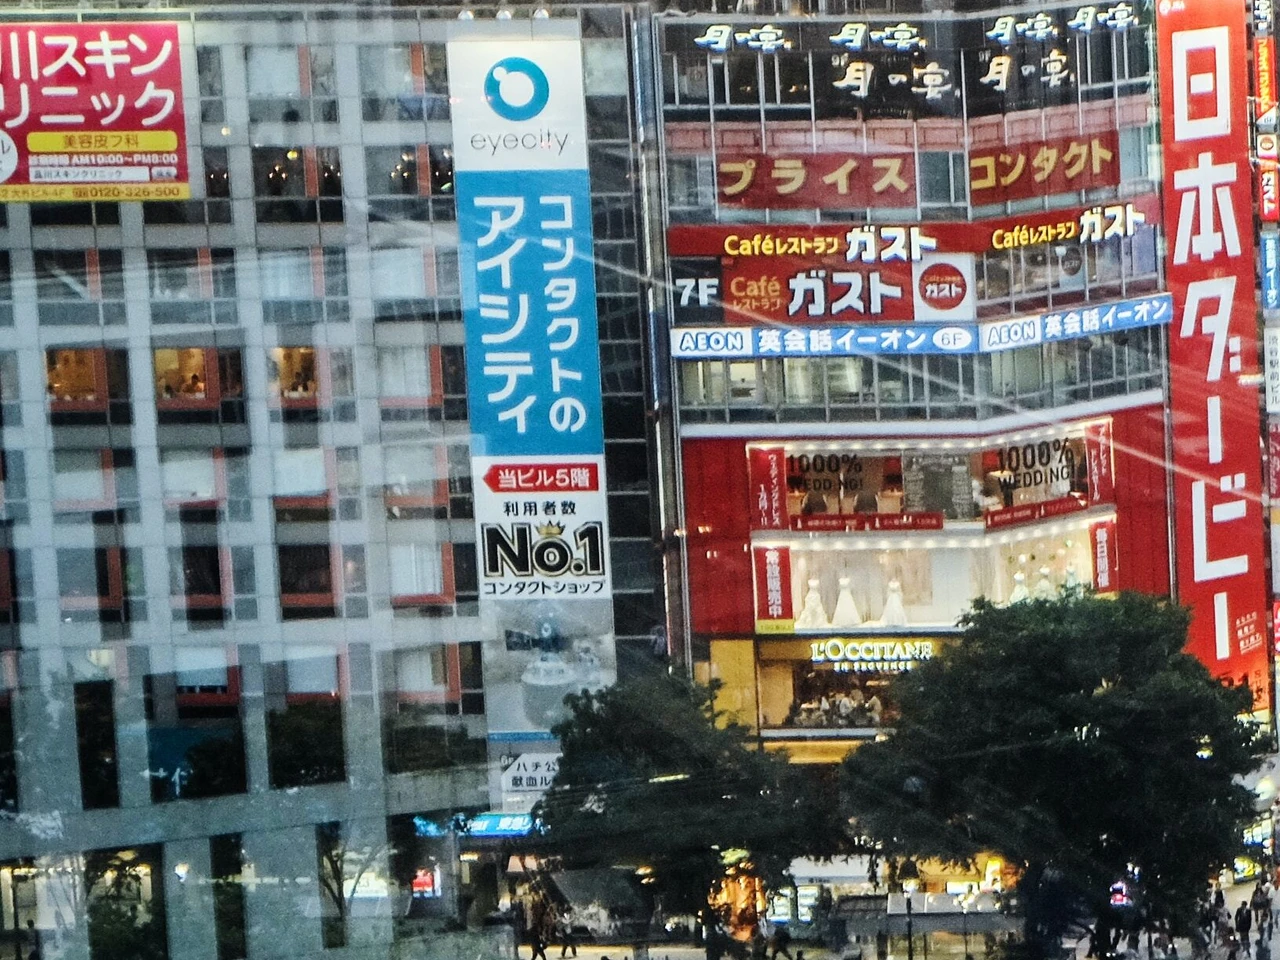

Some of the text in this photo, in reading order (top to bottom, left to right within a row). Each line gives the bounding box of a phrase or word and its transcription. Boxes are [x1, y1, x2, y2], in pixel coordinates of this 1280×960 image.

[62, 134, 139, 149] 美容皮フ科
[470, 128, 569, 156] eyecity
[719, 158, 909, 196] プライス
[970, 138, 1112, 190] コンタクト
[1079, 203, 1145, 244] ガスト
[846, 225, 937, 262] ガスト
[675, 278, 719, 307] 7F
[730, 275, 781, 298] Café
[788, 269, 902, 317] ガスト
[925, 282, 963, 298] ガスト
[472, 196, 537, 434] アイシティ
[539, 195, 588, 434] コンタクトの
[732, 298, 781, 311] レストラン
[1044, 300, 1168, 338] 英会話イーオン
[679, 332, 743, 351] AEON
[757, 329, 926, 352] 英会話イーオン
[940, 333, 964, 348] 6F
[988, 320, 1036, 347] AEON
[1170, 27, 1248, 660] 日本ダービー
[498, 469, 590, 488] 当ビル5階
[503, 501, 576, 516] 利用者数
[480, 521, 605, 578] No.1
[484, 580, 605, 595] コンタクトショップ
